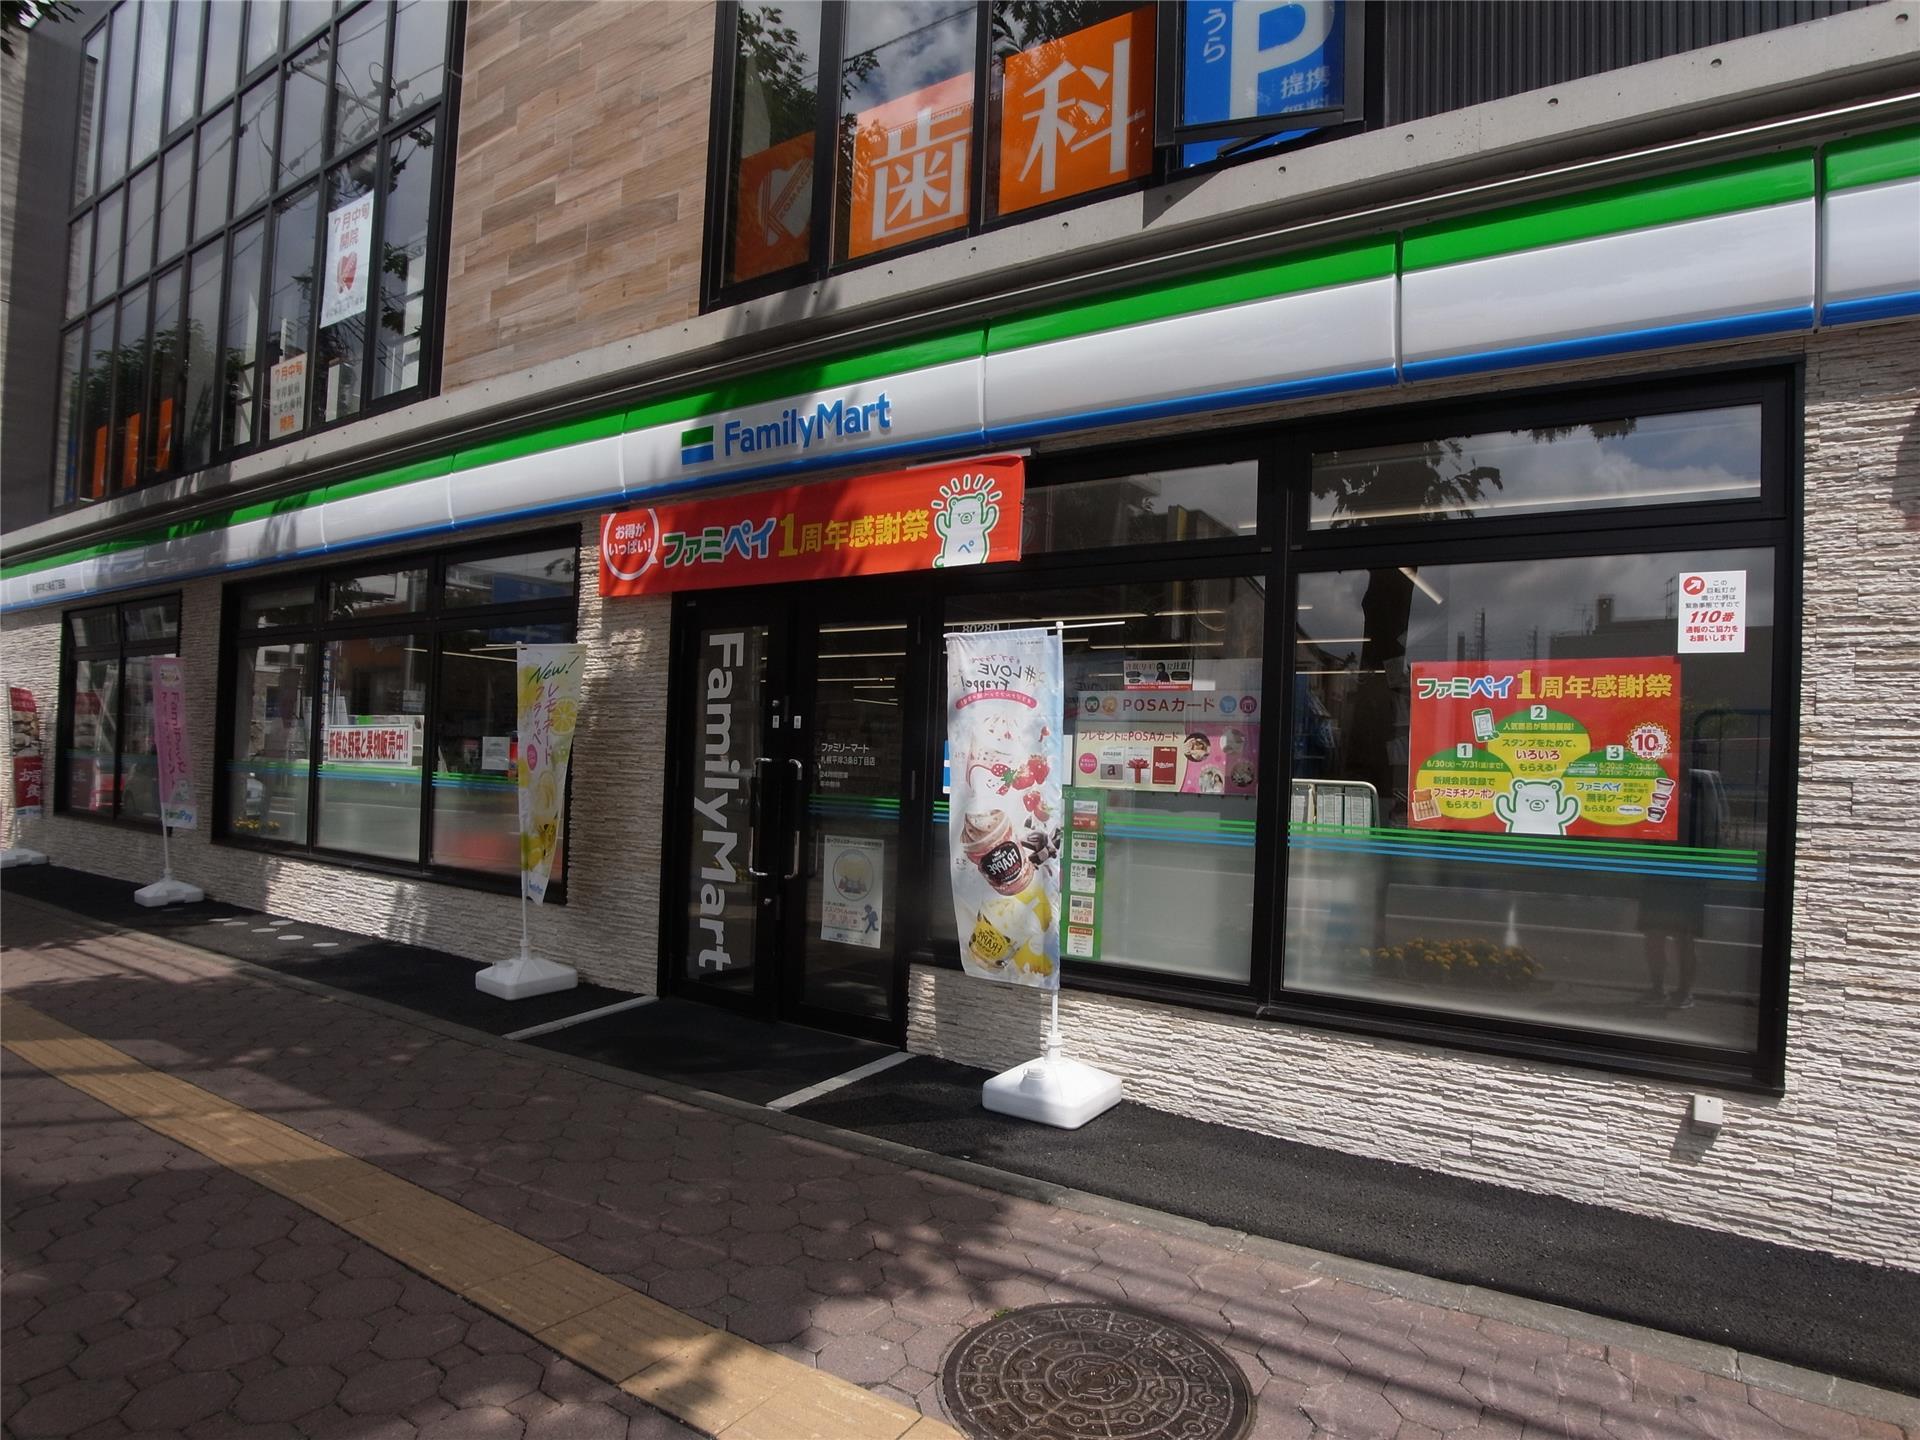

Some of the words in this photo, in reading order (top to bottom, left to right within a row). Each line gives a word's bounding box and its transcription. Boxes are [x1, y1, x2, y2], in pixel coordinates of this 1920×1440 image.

[1203, 8, 1226, 63] うら
[1229, 0, 1335, 119] P
[1280, 66, 1331, 99] 提携
[870, 37, 1146, 242] 歯科
[725, 392, 892, 457] FamilyMart
[614, 522, 646, 540] お得が
[608, 538, 653, 556] いっぱい!
[1690, 609, 1735, 623] 110番
[1685, 625, 1738, 634] 通報のご協力を
[1689, 633, 1735, 642] お願いします
[528, 656, 580, 684] New!
[1122, 697, 1215, 714] POSAカード
[1533, 706, 1544, 719] 2
[1080, 729, 1180, 742] プレゼントにPOSAカード
[821, 743, 870, 754] ファミリーマート
[1460, 745, 1468, 756] 1
[1610, 747, 1620, 759] 3
[1515, 749, 1561, 761] いろいろ
[1107, 764, 1116, 776] a
[1519, 763, 1557, 773] もらえる!
[1433, 775, 1495, 787] 新規会員登録で
[1575, 781, 1621, 792] ファミペイ
[1434, 787, 1497, 799] ファミチキクーポン
[694, 632, 745, 972] FamilyMart
[1446, 801, 1482, 810] もらえる!
[1584, 804, 1616, 813] もらえる!
